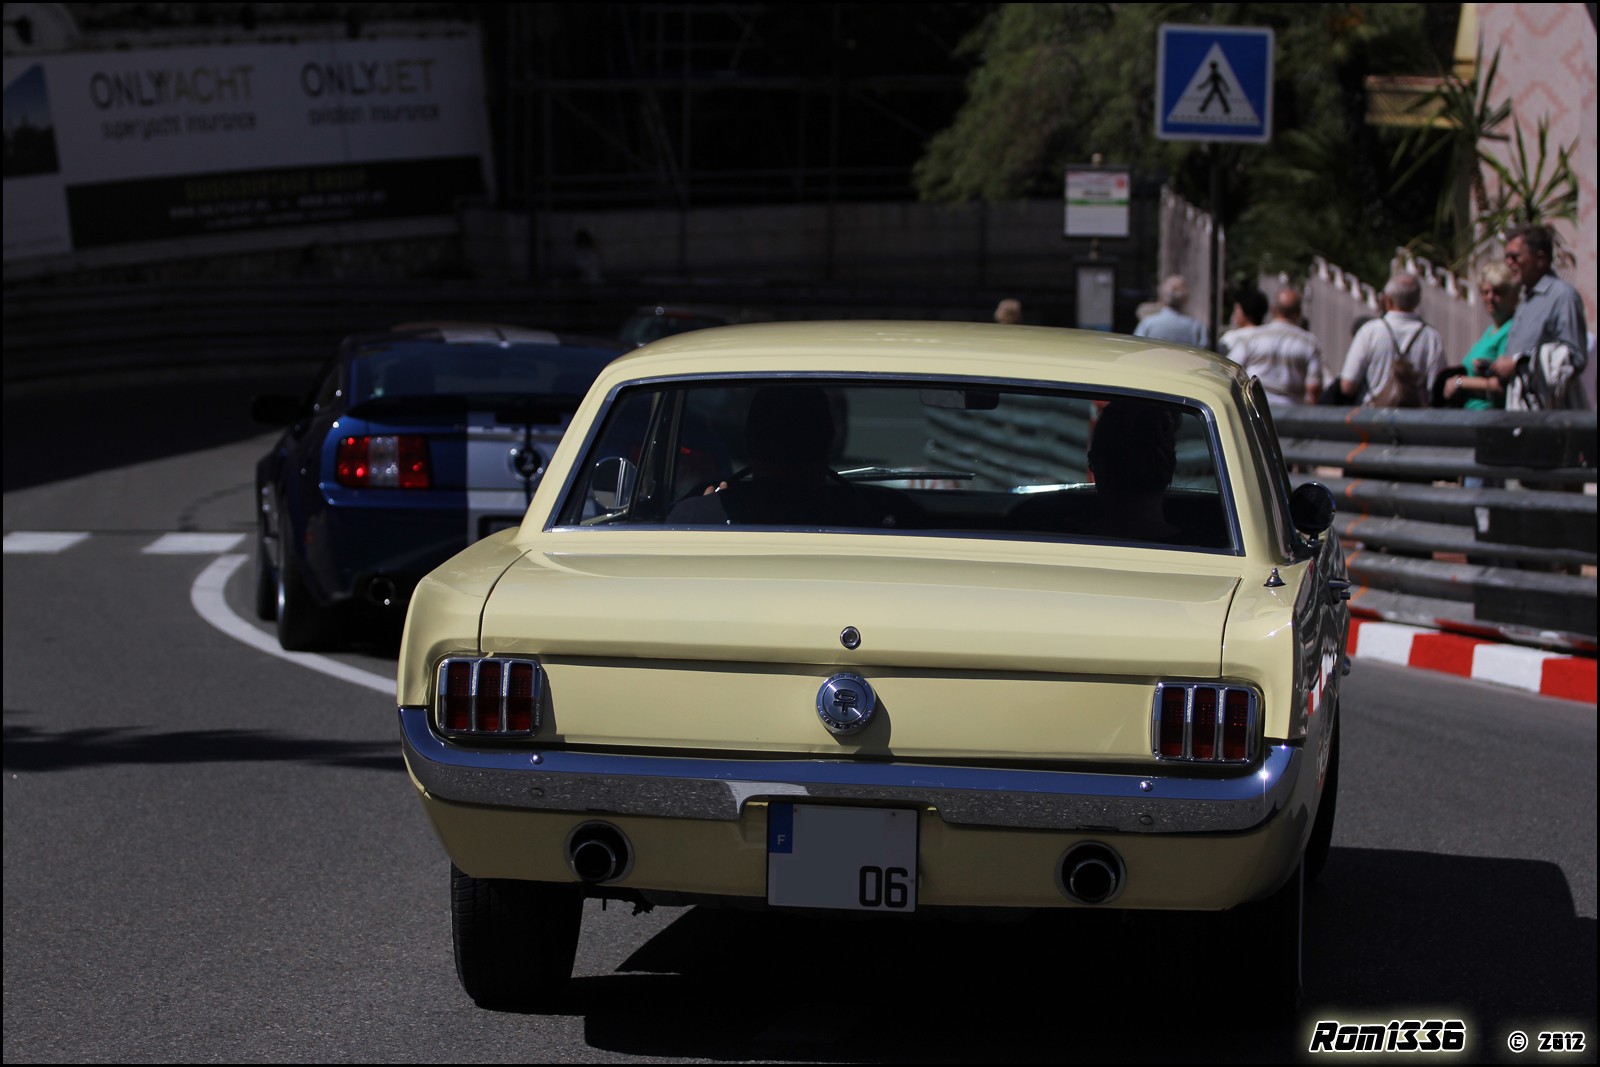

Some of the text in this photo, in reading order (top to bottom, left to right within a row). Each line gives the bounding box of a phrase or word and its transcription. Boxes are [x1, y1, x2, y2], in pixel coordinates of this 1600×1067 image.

[301, 59, 436, 98] ONLYJET
[186, 112, 258, 133] insurance
[370, 103, 440, 122] insurance
[776, 834, 786, 846] F
[859, 865, 908, 908] 06
